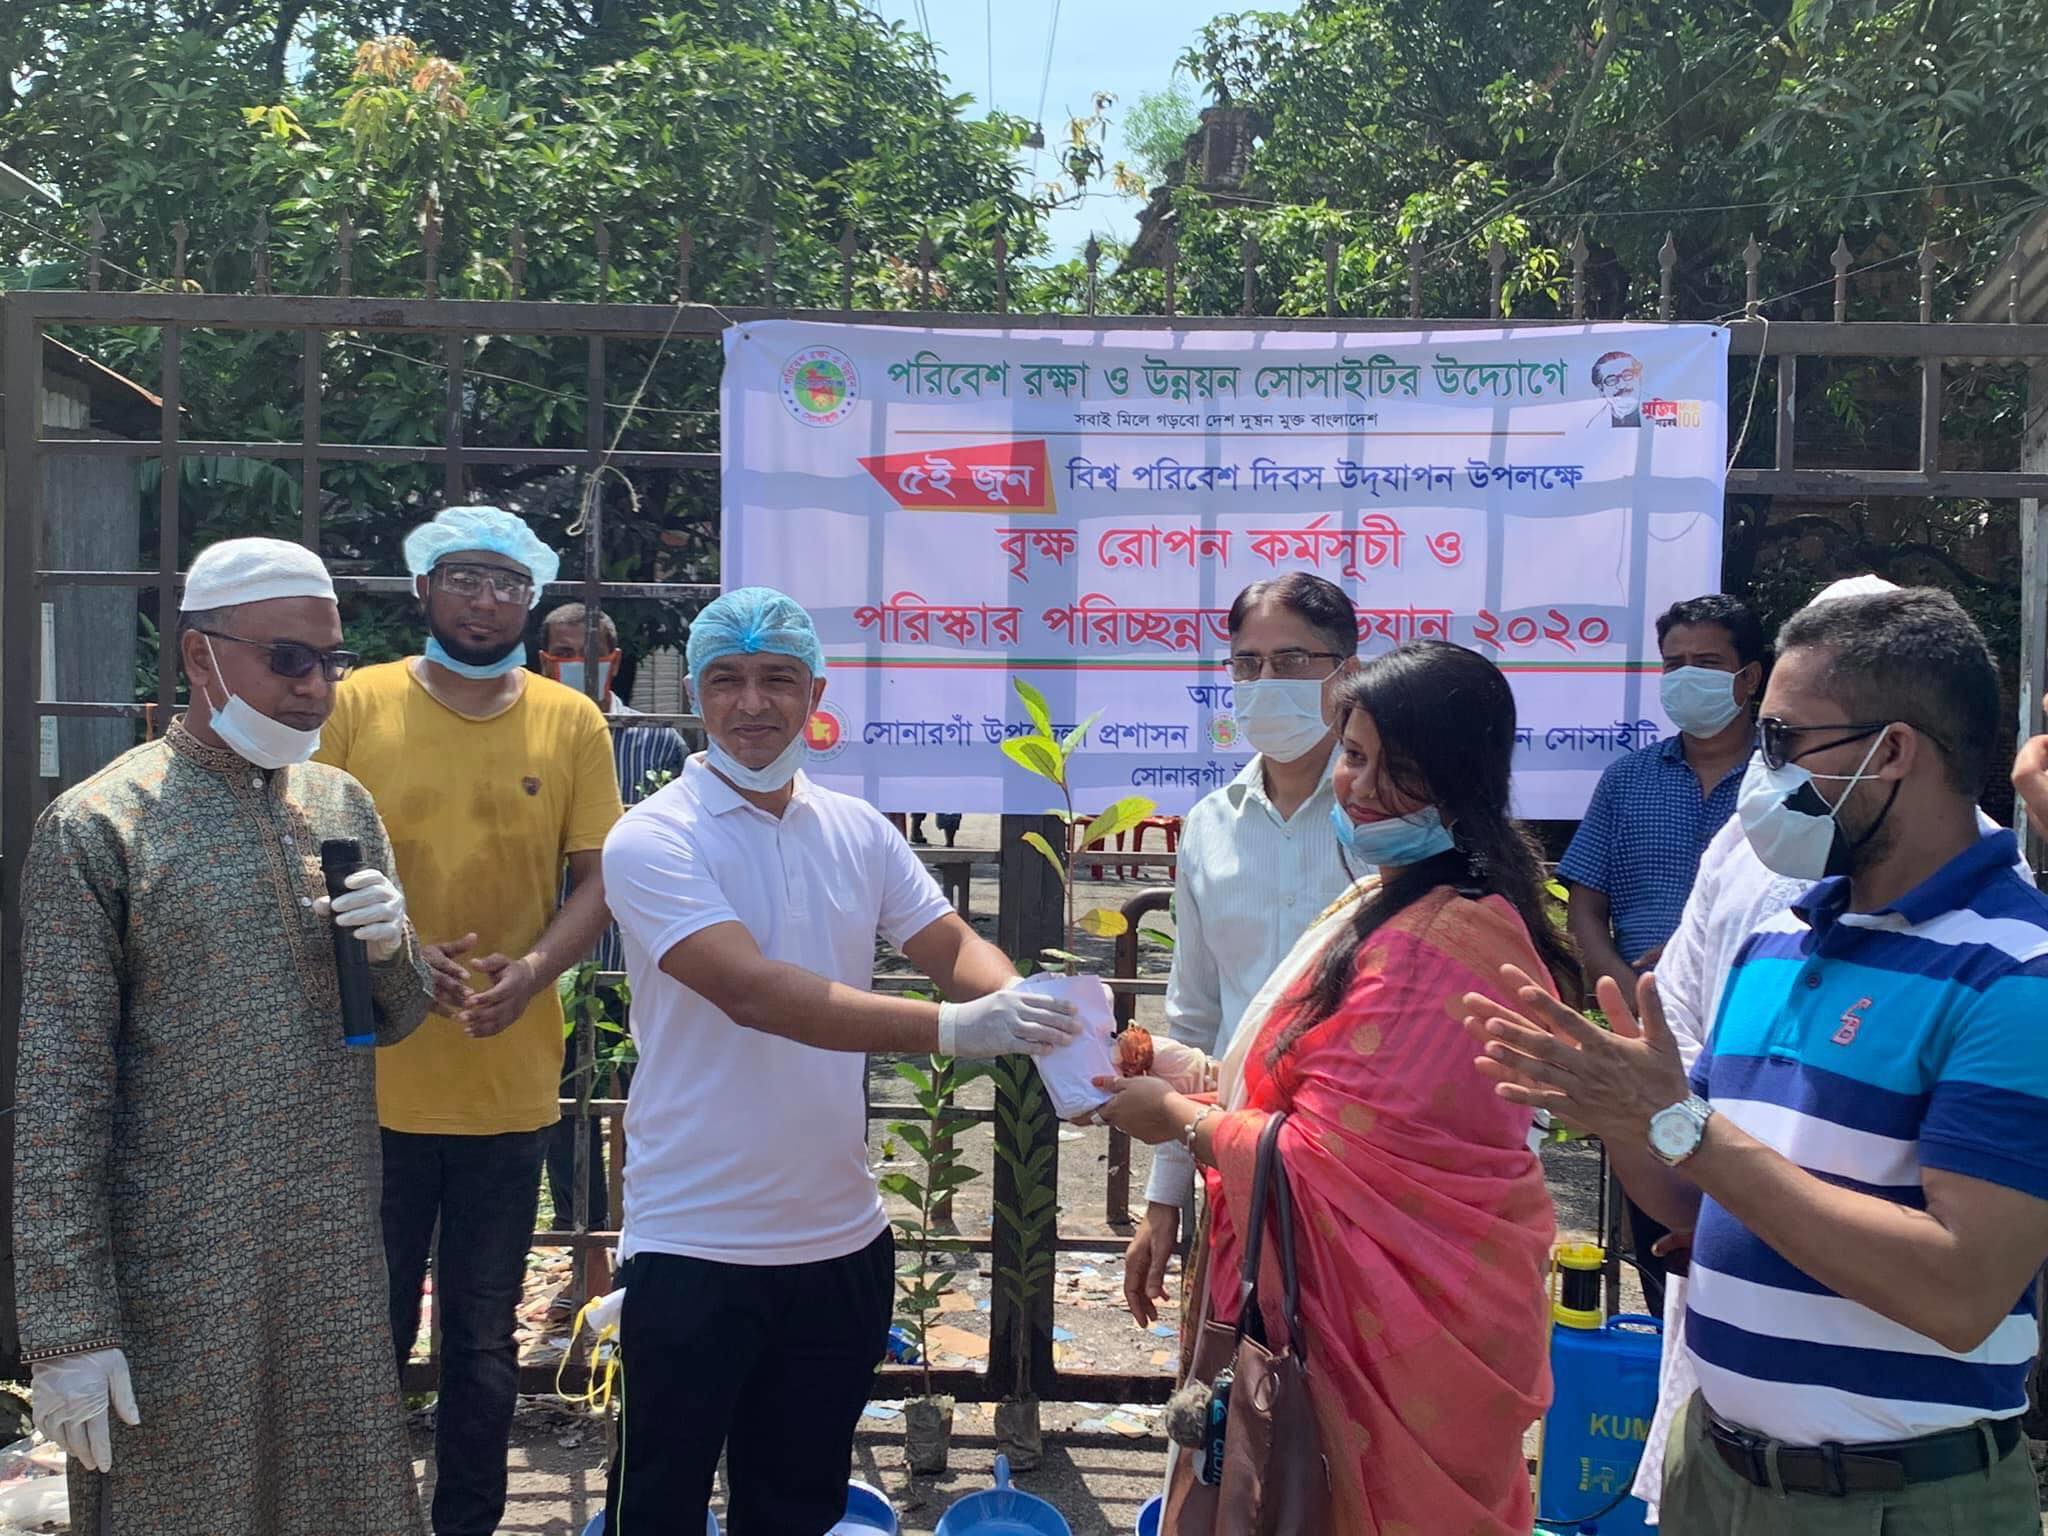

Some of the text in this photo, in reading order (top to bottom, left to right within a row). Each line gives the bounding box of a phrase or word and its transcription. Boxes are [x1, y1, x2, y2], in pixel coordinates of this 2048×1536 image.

[887, 350, 1011, 397] পরিবেশ
[1020, 359, 1090, 399] রক্ষা
[1103, 365, 1129, 396] ও
[1140, 353, 1242, 405] উন্নয়ন
[1254, 353, 1422, 400] সোসাইটির
[1431, 353, 1569, 397] উদ্যোগে
[1073, 410, 1112, 428] সবাই
[1116, 409, 1150, 427] মিলে
[1156, 412, 1201, 430] গড়বো
[1205, 413, 1235, 428] দেশ
[1278, 413, 1306, 431] মুক্ত
[1310, 412, 1379, 428] বাংলাদেশ
[897, 453, 1034, 505] ৫ই জুন
[1065, 455, 1121, 493] বিশ্ব
[1131, 457, 1241, 492] পরিবেশ
[1250, 456, 1325, 492] দিবস
[1464, 456, 1585, 491] উপলক্ষে
[994, 513, 1463, 584] বৃক্ষ রোপন কর্মসূচী ও
[852, 590, 1023, 646] পরিস্কার
[1040, 592, 1232, 655] পরিচ্ছন্নত
[1472, 607, 1611, 652] ২০২০
[862, 713, 974, 747] সোনারগাঁ
[1098, 721, 1190, 749] প্রশাসন
[1131, 760, 1226, 788] সোনারগাঁ
